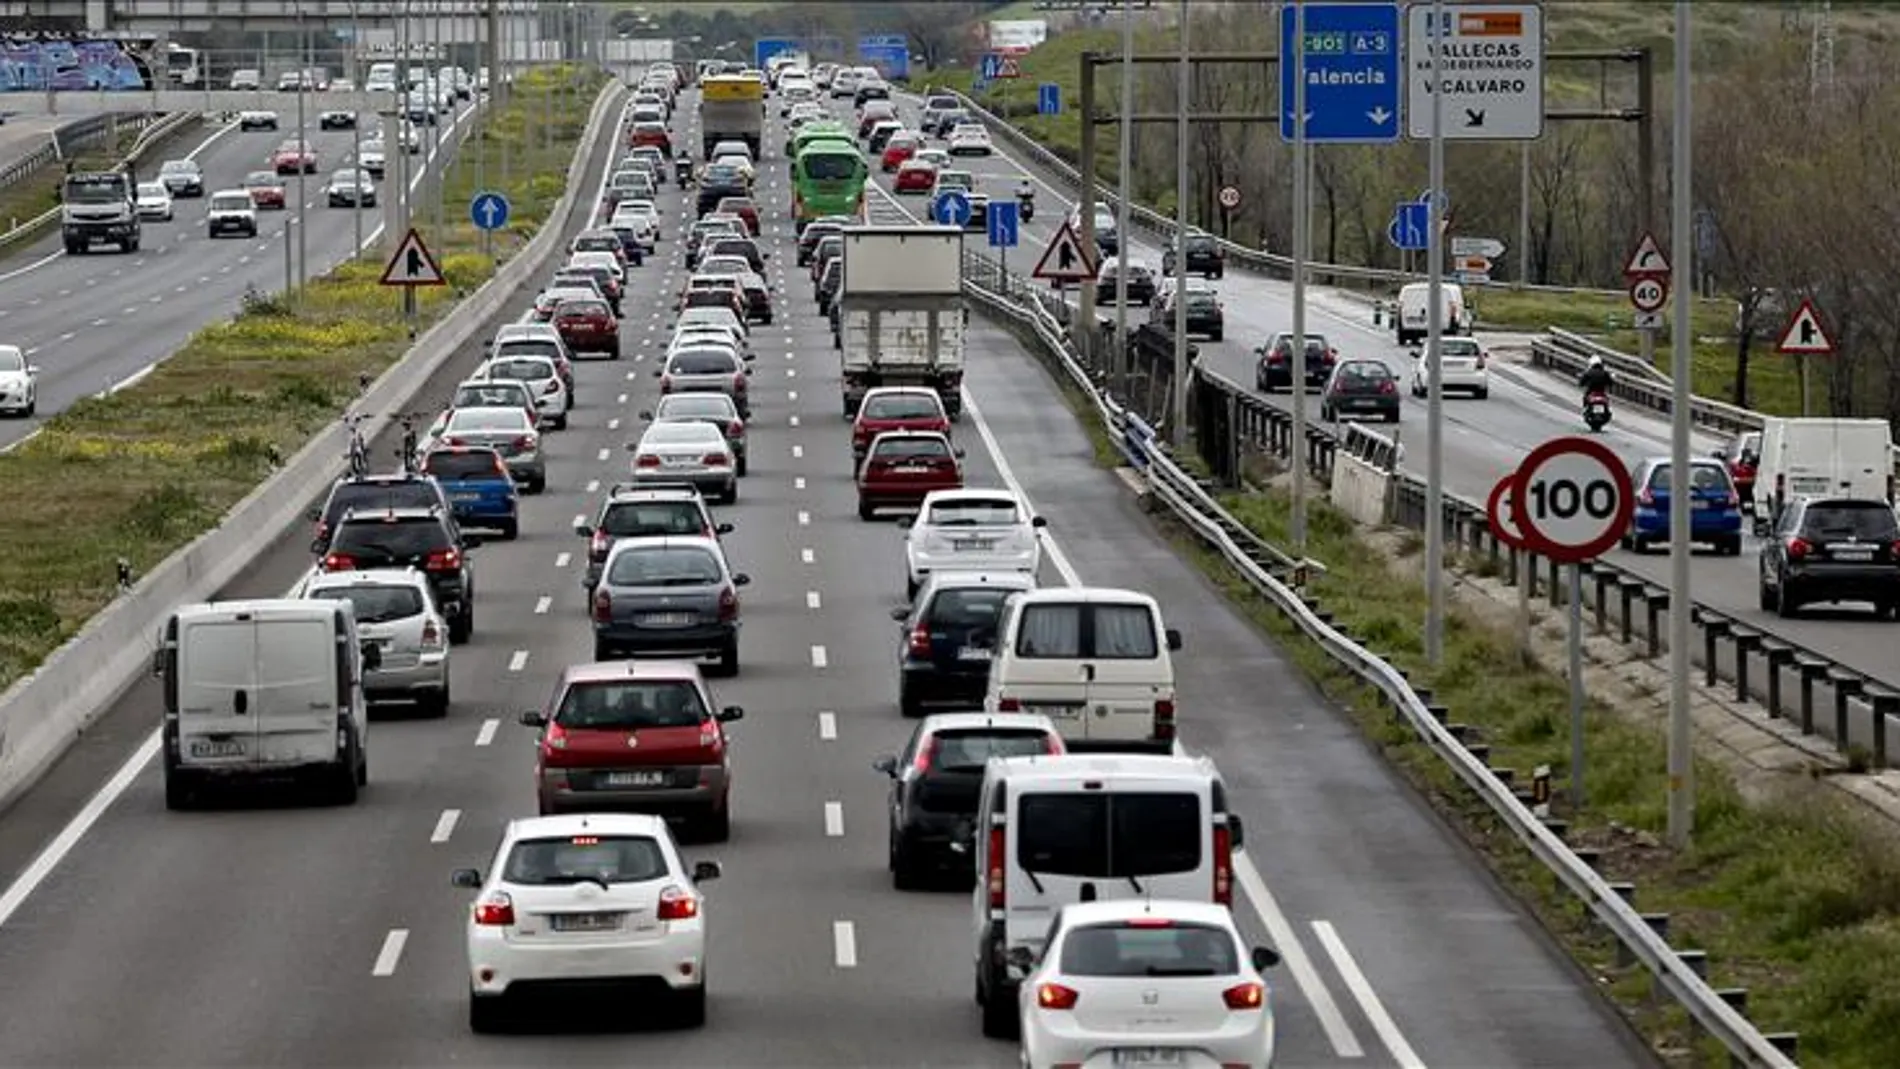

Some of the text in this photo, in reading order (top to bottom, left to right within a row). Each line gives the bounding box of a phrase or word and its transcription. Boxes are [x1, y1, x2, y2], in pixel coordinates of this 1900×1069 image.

[1356, 36, 1385, 50] A-3
[1416, 59, 1535, 70] VADEBERNARDO
[1424, 80, 1525, 94] VCALVARO
[1637, 287, 1659, 299] 40
[1530, 479, 1617, 519] 100
